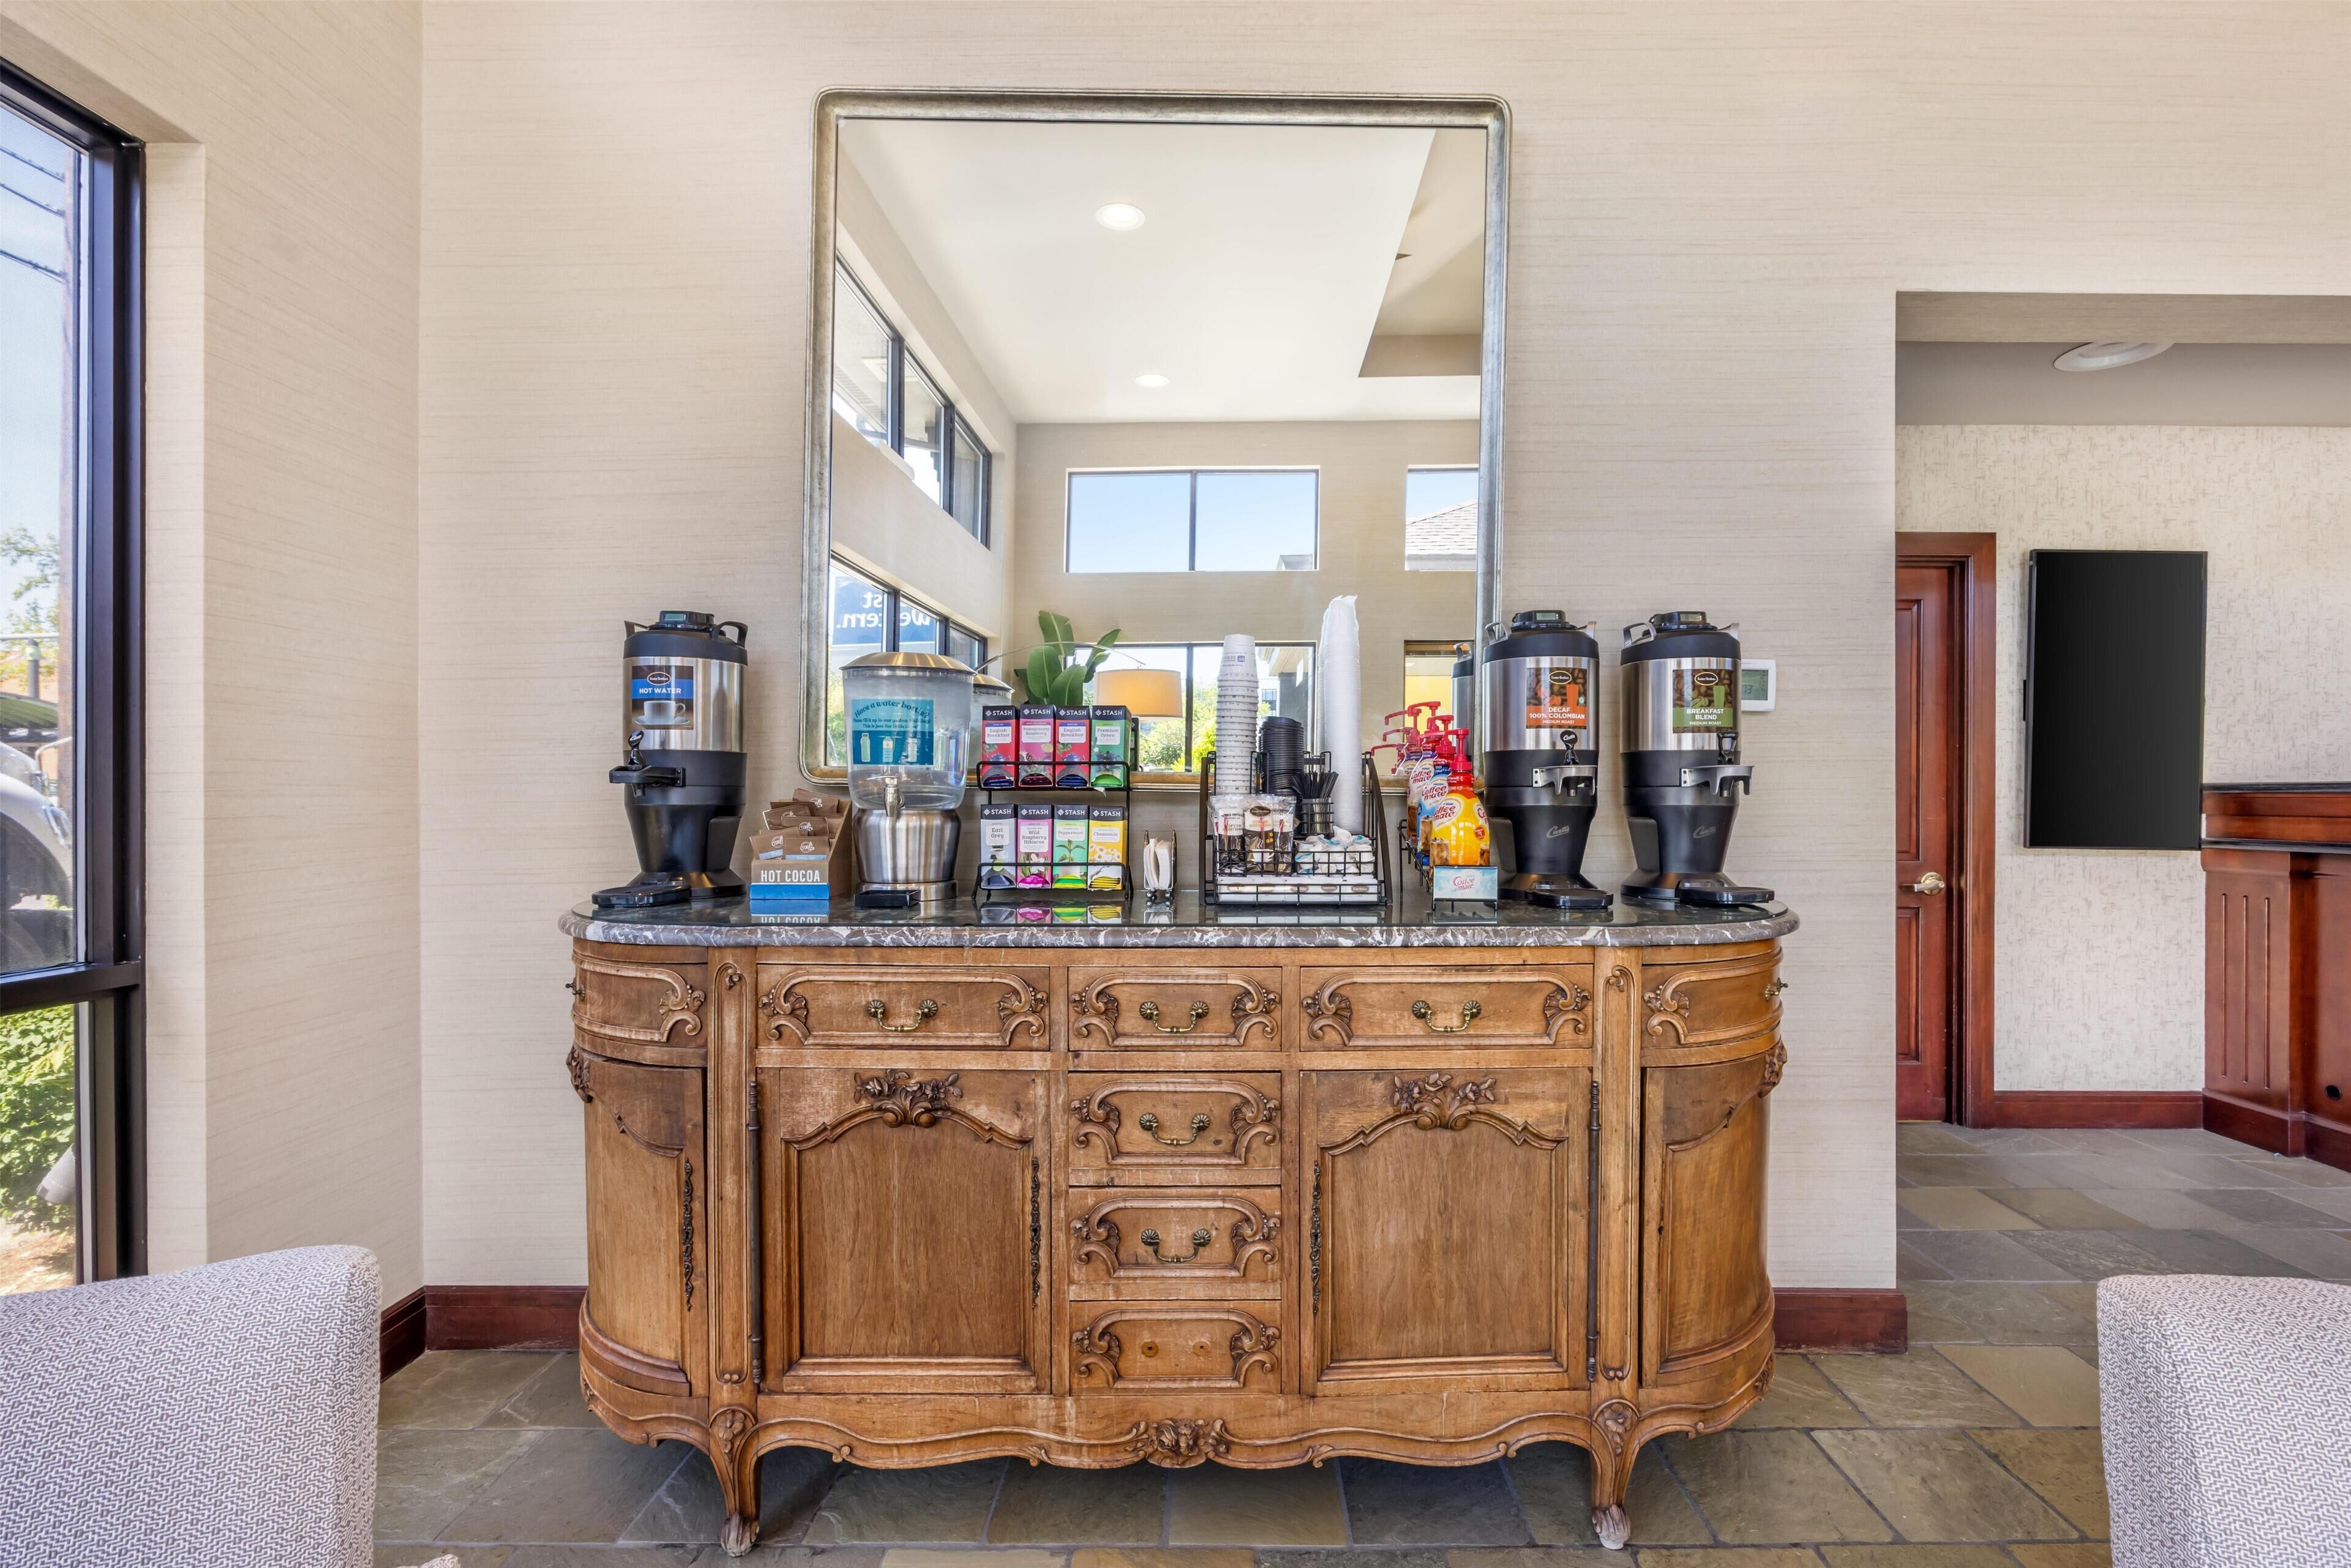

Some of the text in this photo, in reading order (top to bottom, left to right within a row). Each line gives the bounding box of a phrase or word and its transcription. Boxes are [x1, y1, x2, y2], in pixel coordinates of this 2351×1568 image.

[855, 704, 869, 718] Have
[1433, 806, 1456, 816] offee
[761, 870, 820, 882] HOT COCOA
